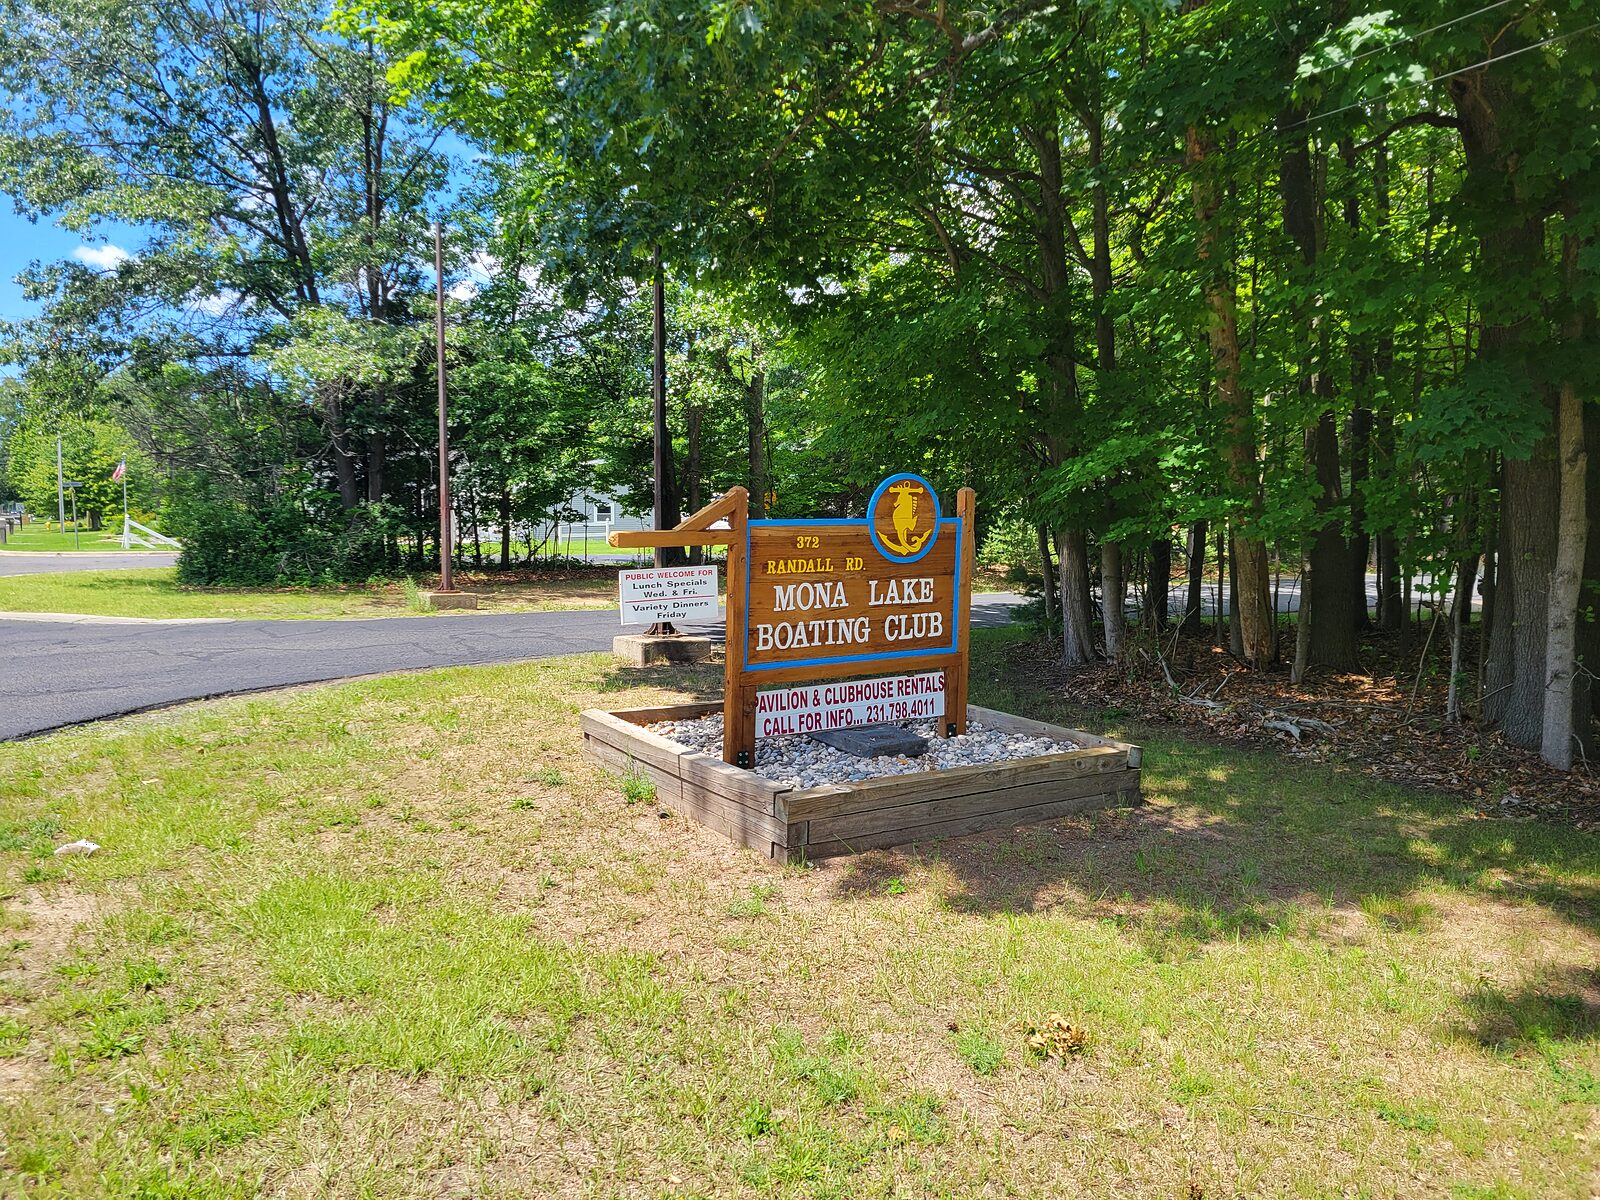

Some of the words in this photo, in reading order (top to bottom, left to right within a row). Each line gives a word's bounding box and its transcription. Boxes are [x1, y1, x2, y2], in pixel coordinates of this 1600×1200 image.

[796, 536, 820, 549] 372
[766, 557, 834, 574] RANDALL
[845, 557, 866, 571] RD.
[657, 570, 695, 579] WELCOME
[632, 581, 662, 590] Lunch
[666, 579, 707, 589] Specials
[643, 590, 667, 598] Wed.
[773, 581, 849, 612] MONA
[868, 577, 934, 606] LAKE
[632, 604, 668, 612] Variety
[657, 611, 687, 619] Friday
[756, 616, 872, 651] BOATING
[884, 611, 943, 642] CLUB
[812, 689, 821, 707] &
[824, 680, 894, 706] CLUBHOUSE
[897, 674, 945, 697] RENTALS
[763, 716, 795, 736] CALL
[799, 712, 822, 732] FOR
[822, 708, 863, 729] INFO...
[866, 697, 935, 723] 231.798.4011
